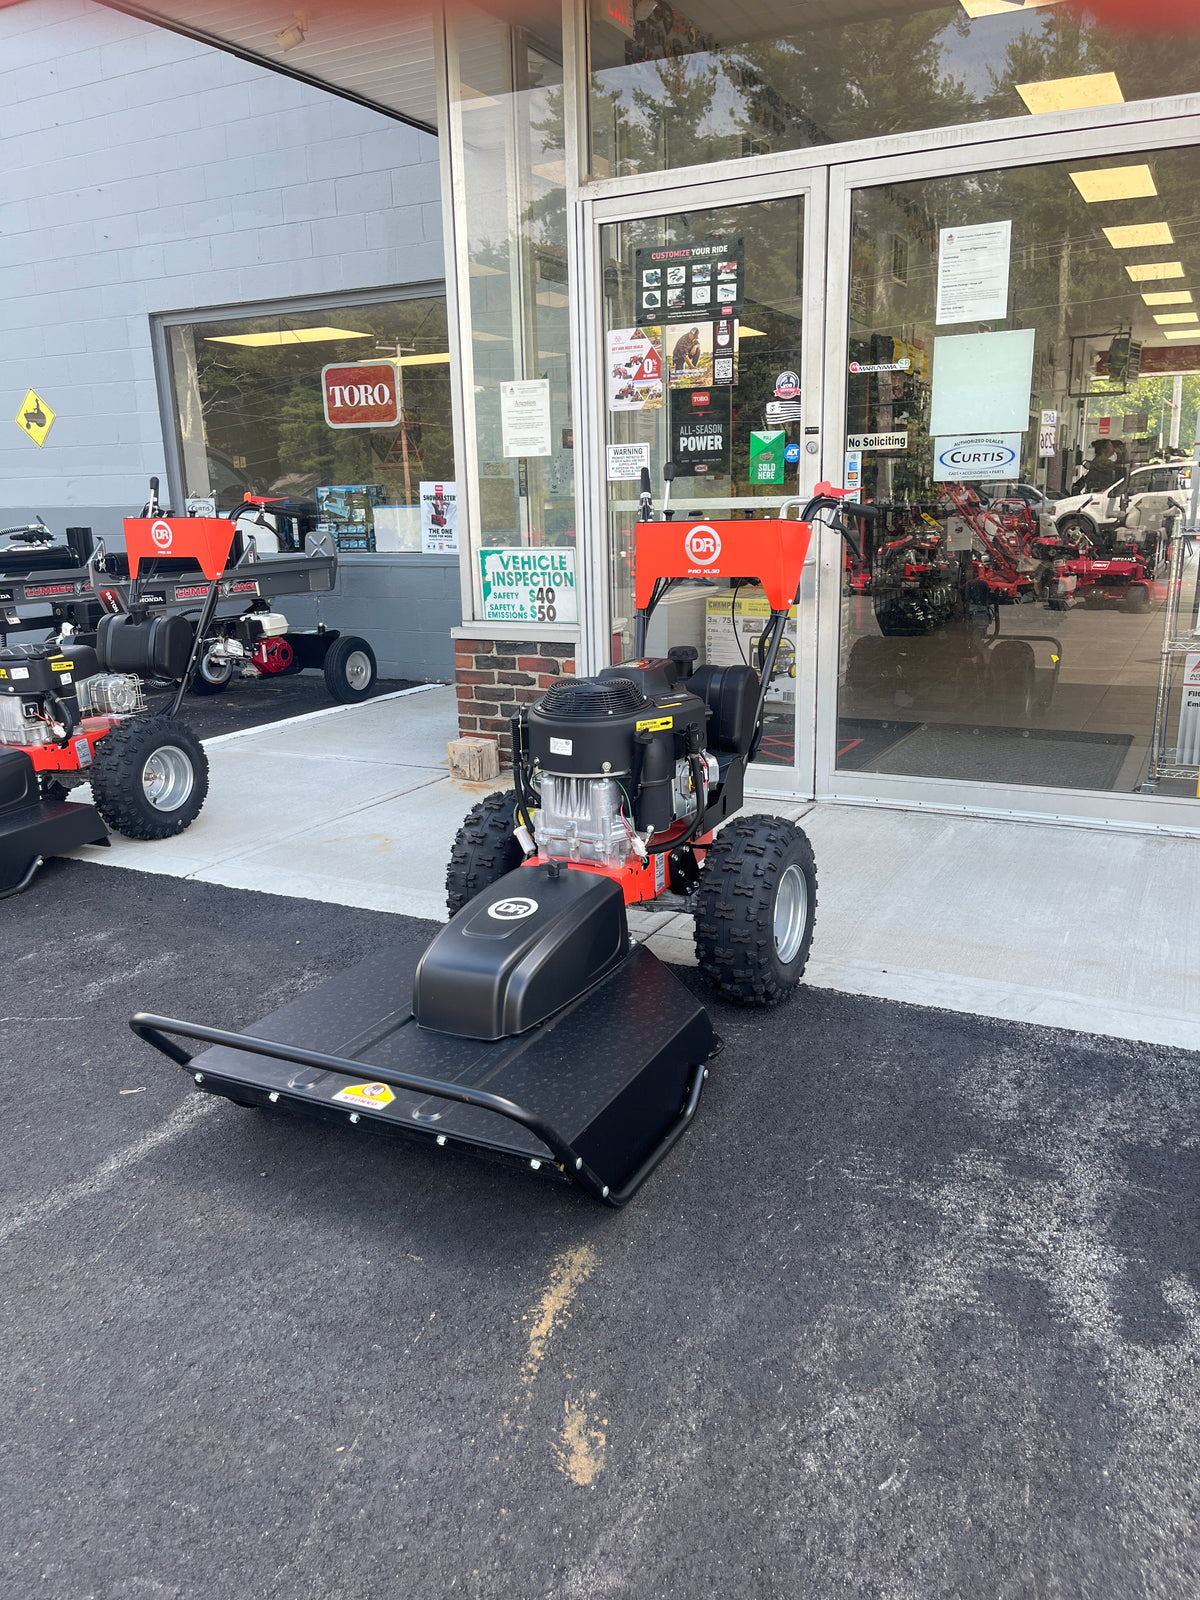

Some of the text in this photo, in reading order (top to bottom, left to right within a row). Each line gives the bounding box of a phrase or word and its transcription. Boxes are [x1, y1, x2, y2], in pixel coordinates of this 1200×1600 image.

[651, 249, 690, 260] CUSTOMIZE
[691, 247, 711, 256] YOUR
[711, 244, 728, 254] RIDE
[859, 364, 898, 372] MARUYAMA
[329, 382, 391, 408] TORO
[680, 423, 723, 436] ALL-SEASON
[680, 435, 723, 452] POWER
[848, 435, 906, 448] No Soliciting
[953, 438, 985, 447] AUTHORIZED
[613, 447, 643, 456] WARNING
[786, 448, 800, 457] ADT
[950, 451, 1004, 463] CURTIS
[758, 463, 776, 472] SOLD
[757, 471, 776, 480] HERE
[155, 529, 169, 540] DR
[691, 537, 715, 553] DR
[498, 555, 567, 570] VEHICLE
[491, 571, 574, 587] INSPECTION
[26, 584, 74, 597] LUMBER
[493, 587, 556, 604] SAFETY $40
[487, 604, 557, 622] EMISSIONS $50
[489, 603, 516, 611] SAFETY
[495, 902, 530, 915] DR
[343, 1095, 378, 1106] DANGER
